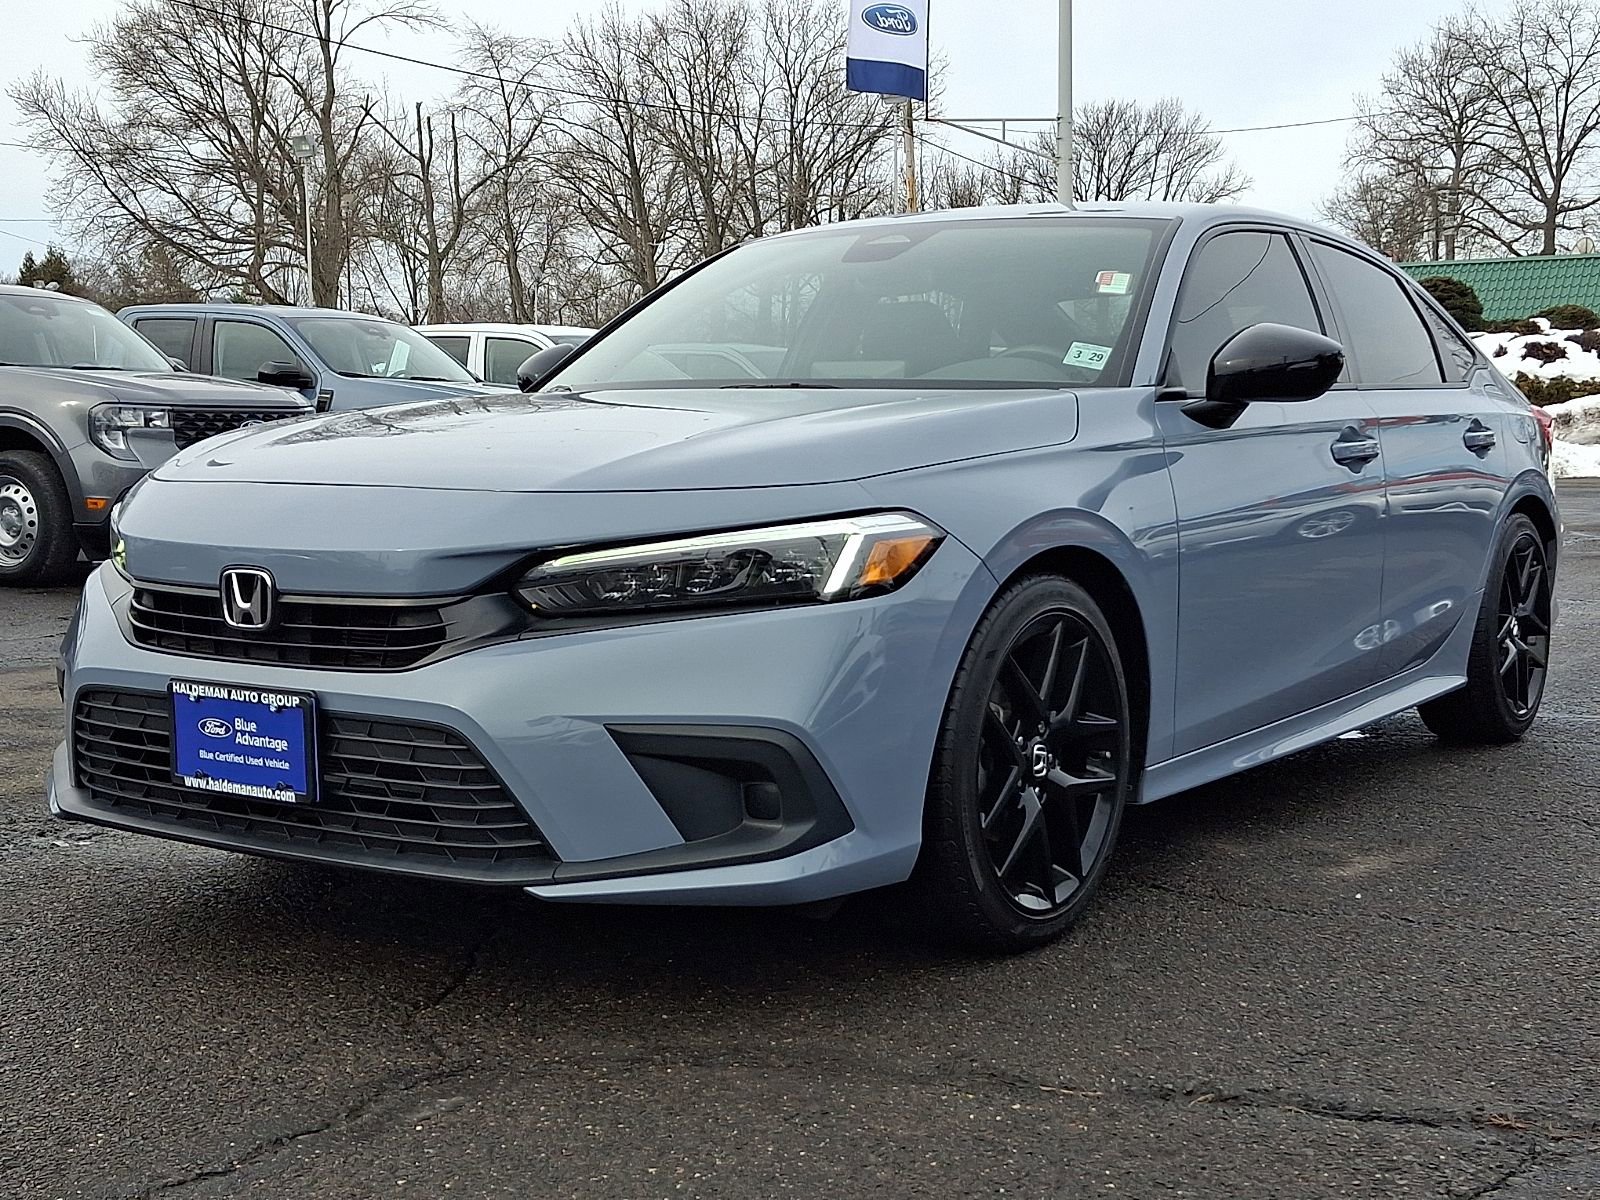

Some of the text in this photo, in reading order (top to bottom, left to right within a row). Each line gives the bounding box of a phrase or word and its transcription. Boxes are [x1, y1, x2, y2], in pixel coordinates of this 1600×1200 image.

[1073, 350, 1104, 362] 3 29
[172, 682, 300, 708] HALDEMAN AUTO GROUP
[204, 720, 227, 735] Ford
[234, 717, 257, 732] Blue
[235, 732, 288, 751] Advantage
[199, 750, 290, 770] Blue Certified Used Vehicle
[184, 775, 296, 803] www.haldemanauto.com
